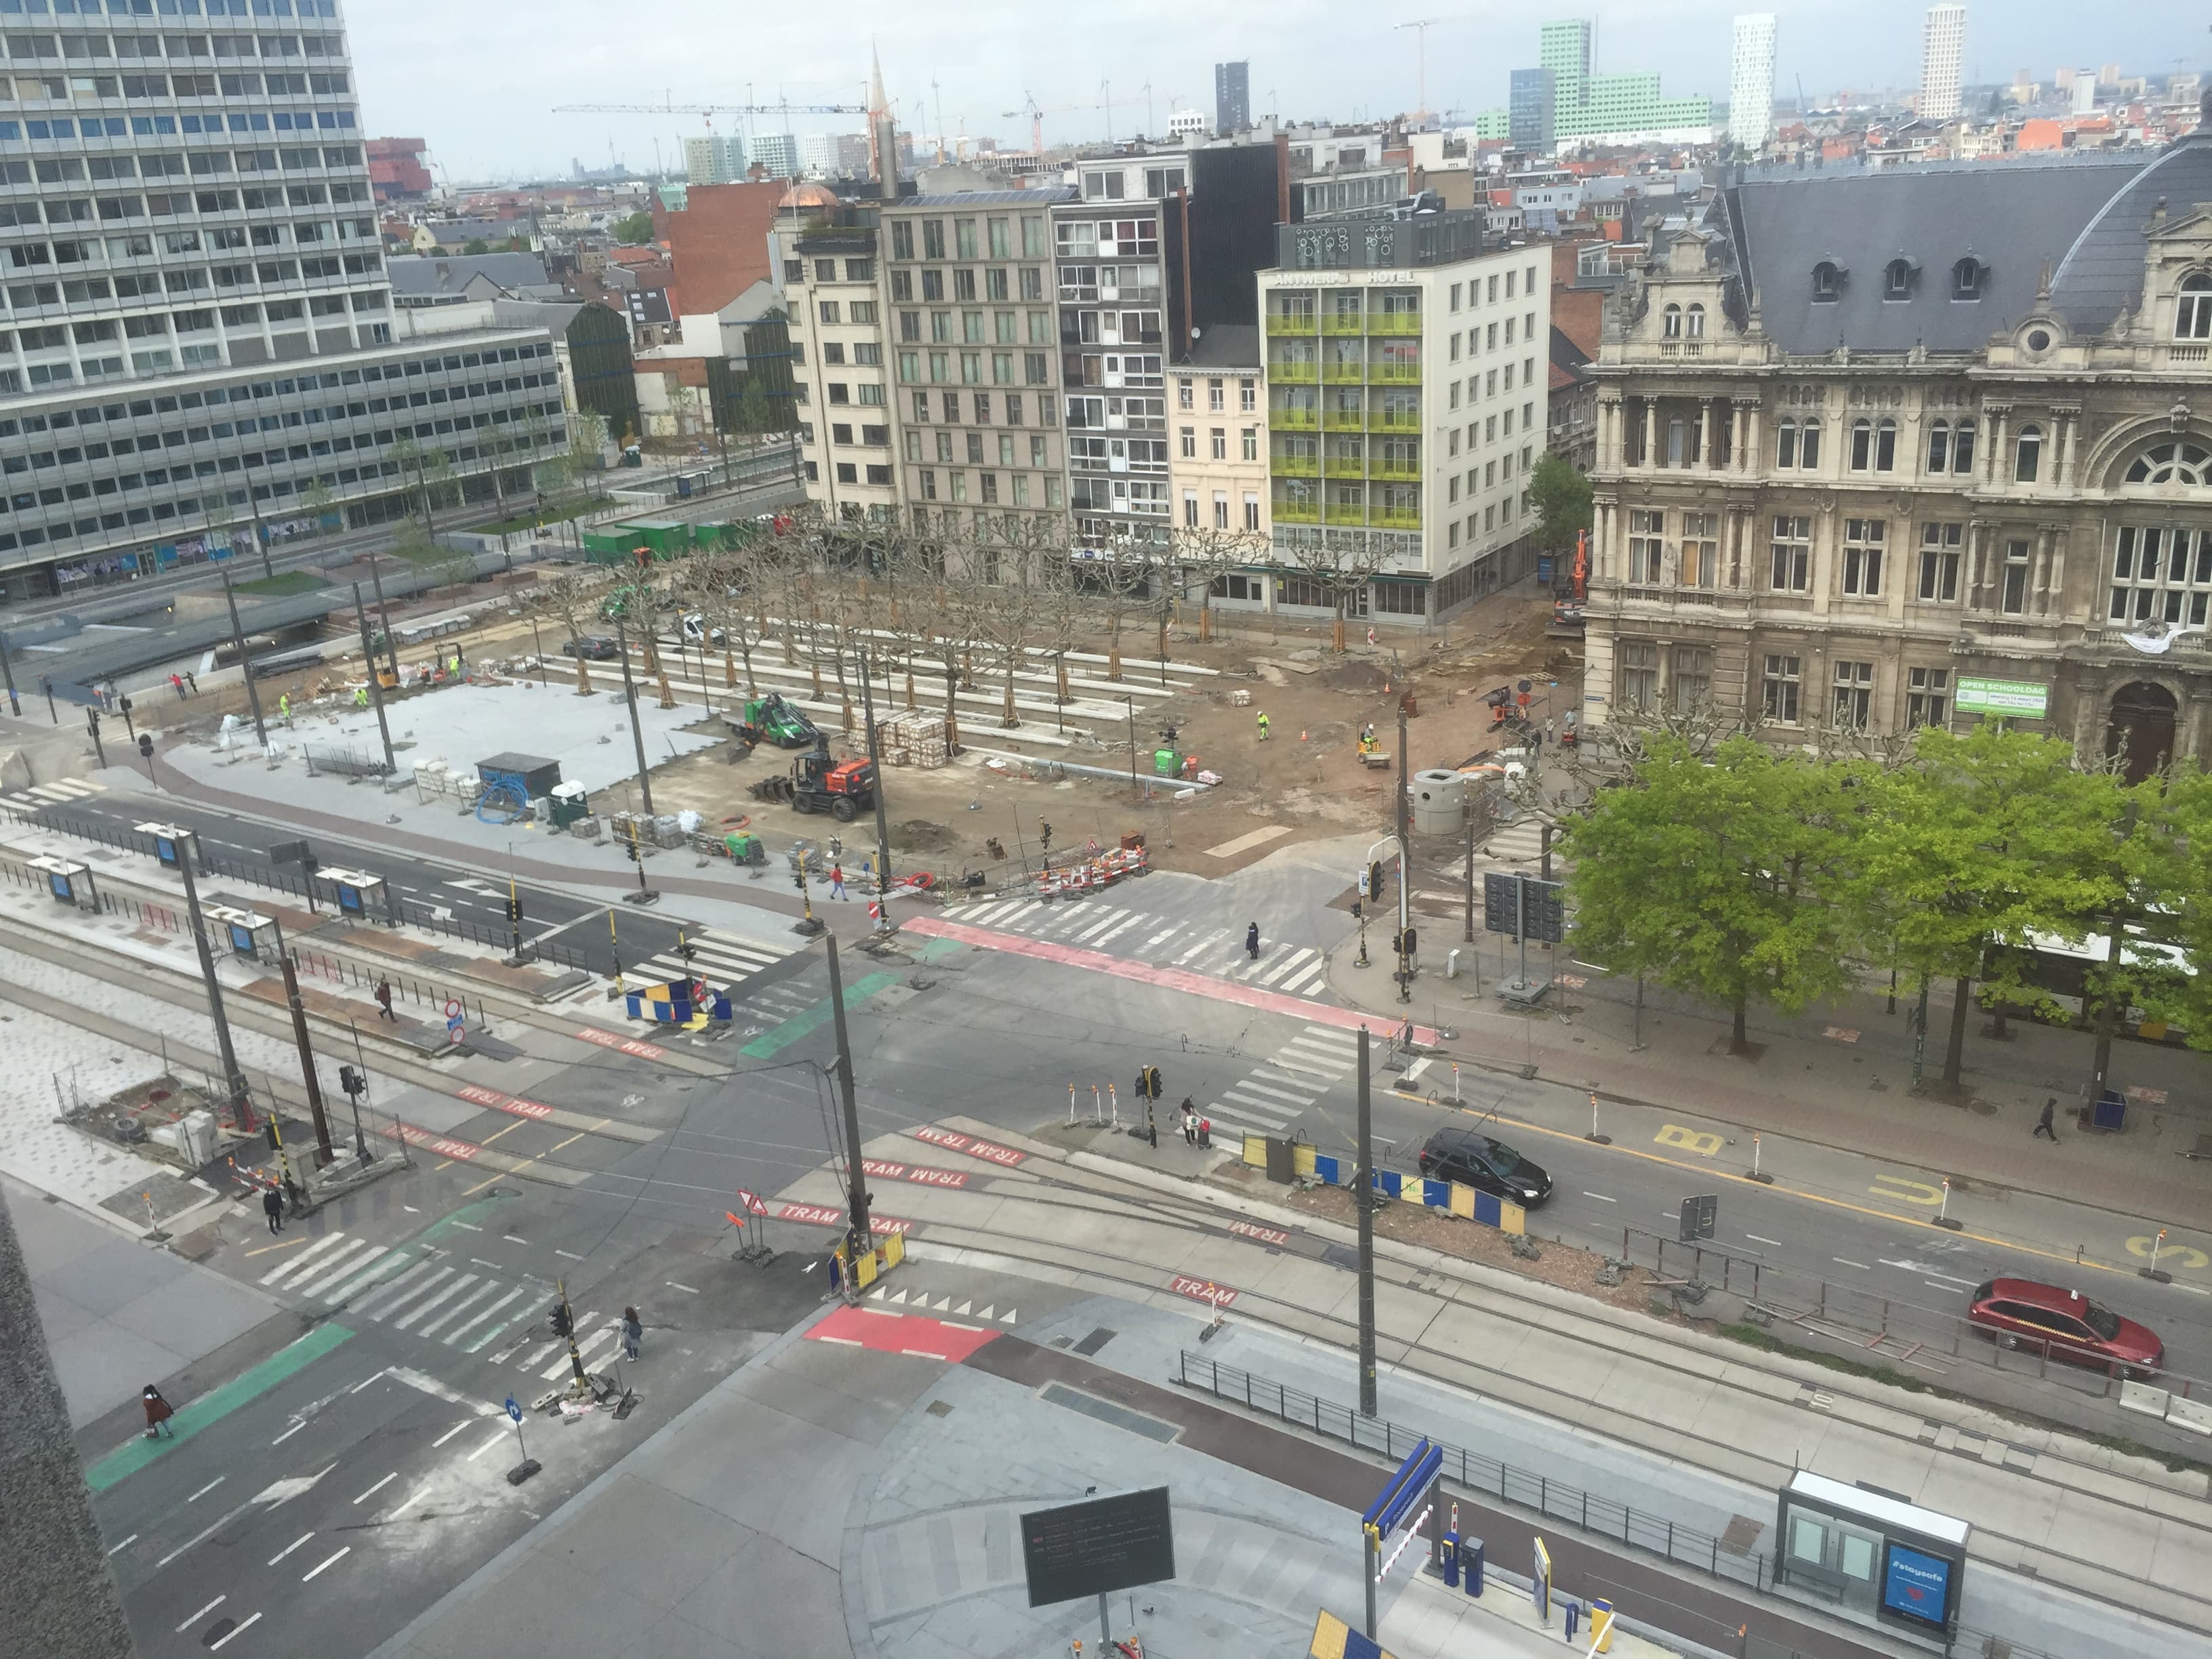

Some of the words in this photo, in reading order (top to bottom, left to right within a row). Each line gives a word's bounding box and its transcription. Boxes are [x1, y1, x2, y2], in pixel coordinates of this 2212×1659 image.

[1367, 271, 1415, 283] HOTEL
[1959, 680, 1985, 689] OPEN
[1987, 683, 2045, 695] SCHOOLDAG
[622, 1040, 662, 1057] TRAM
[458, 1086, 501, 1104] TRAM
[507, 1100, 551, 1118] TRAM
[919, 1127, 966, 1147] TRAM
[432, 1140, 476, 1158] TRAM
[970, 1142, 1018, 1164] TRAM
[862, 1162, 905, 1176] RAM
[910, 1169, 964, 1185] TRAM
[785, 1205, 840, 1223] TRAM
[869, 1217, 910, 1233] RAM
[1230, 1221, 1287, 1245] TRAM
[1176, 1278, 1235, 1304] TRAM
[1892, 1560, 1943, 1582] #staysafe
